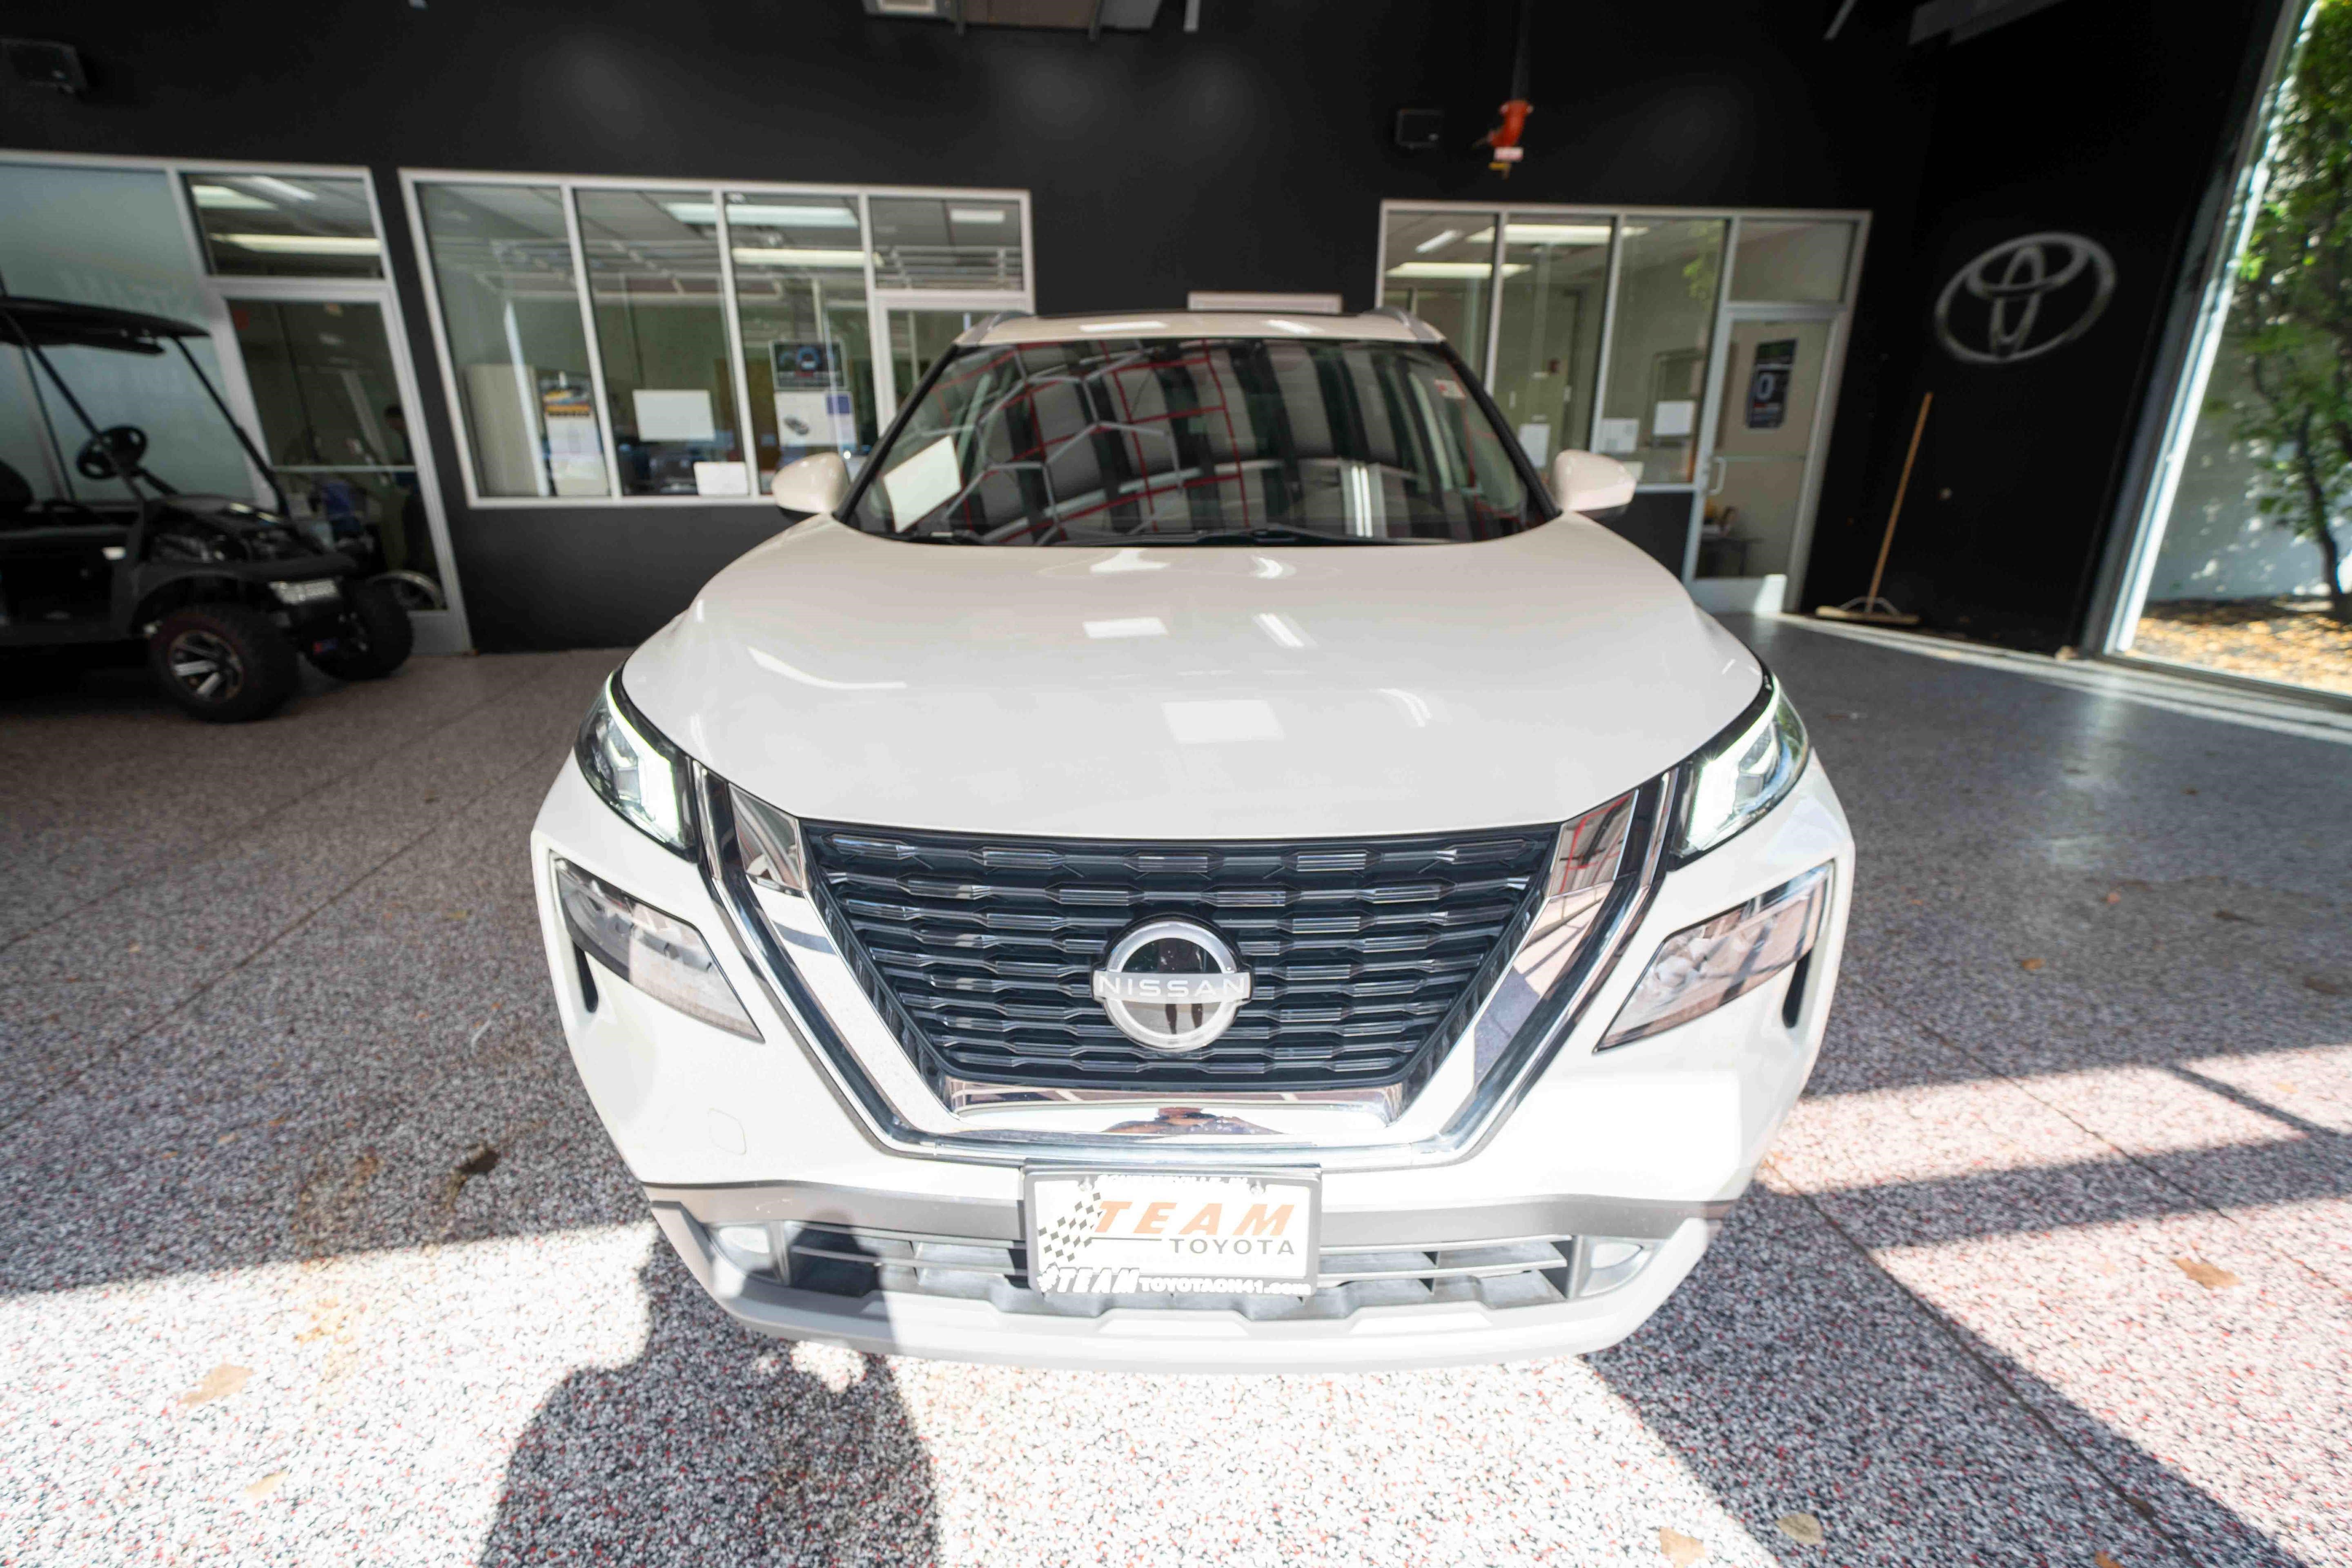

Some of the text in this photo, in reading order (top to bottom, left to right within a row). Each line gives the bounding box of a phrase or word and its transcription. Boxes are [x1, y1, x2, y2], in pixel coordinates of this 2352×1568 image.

[1099, 976, 1245, 998] NISSAN
[1094, 1201, 1294, 1236] TEAM
[1169, 1238, 1294, 1254] TOYOTA
[1057, 1267, 1140, 1293] TEAM
